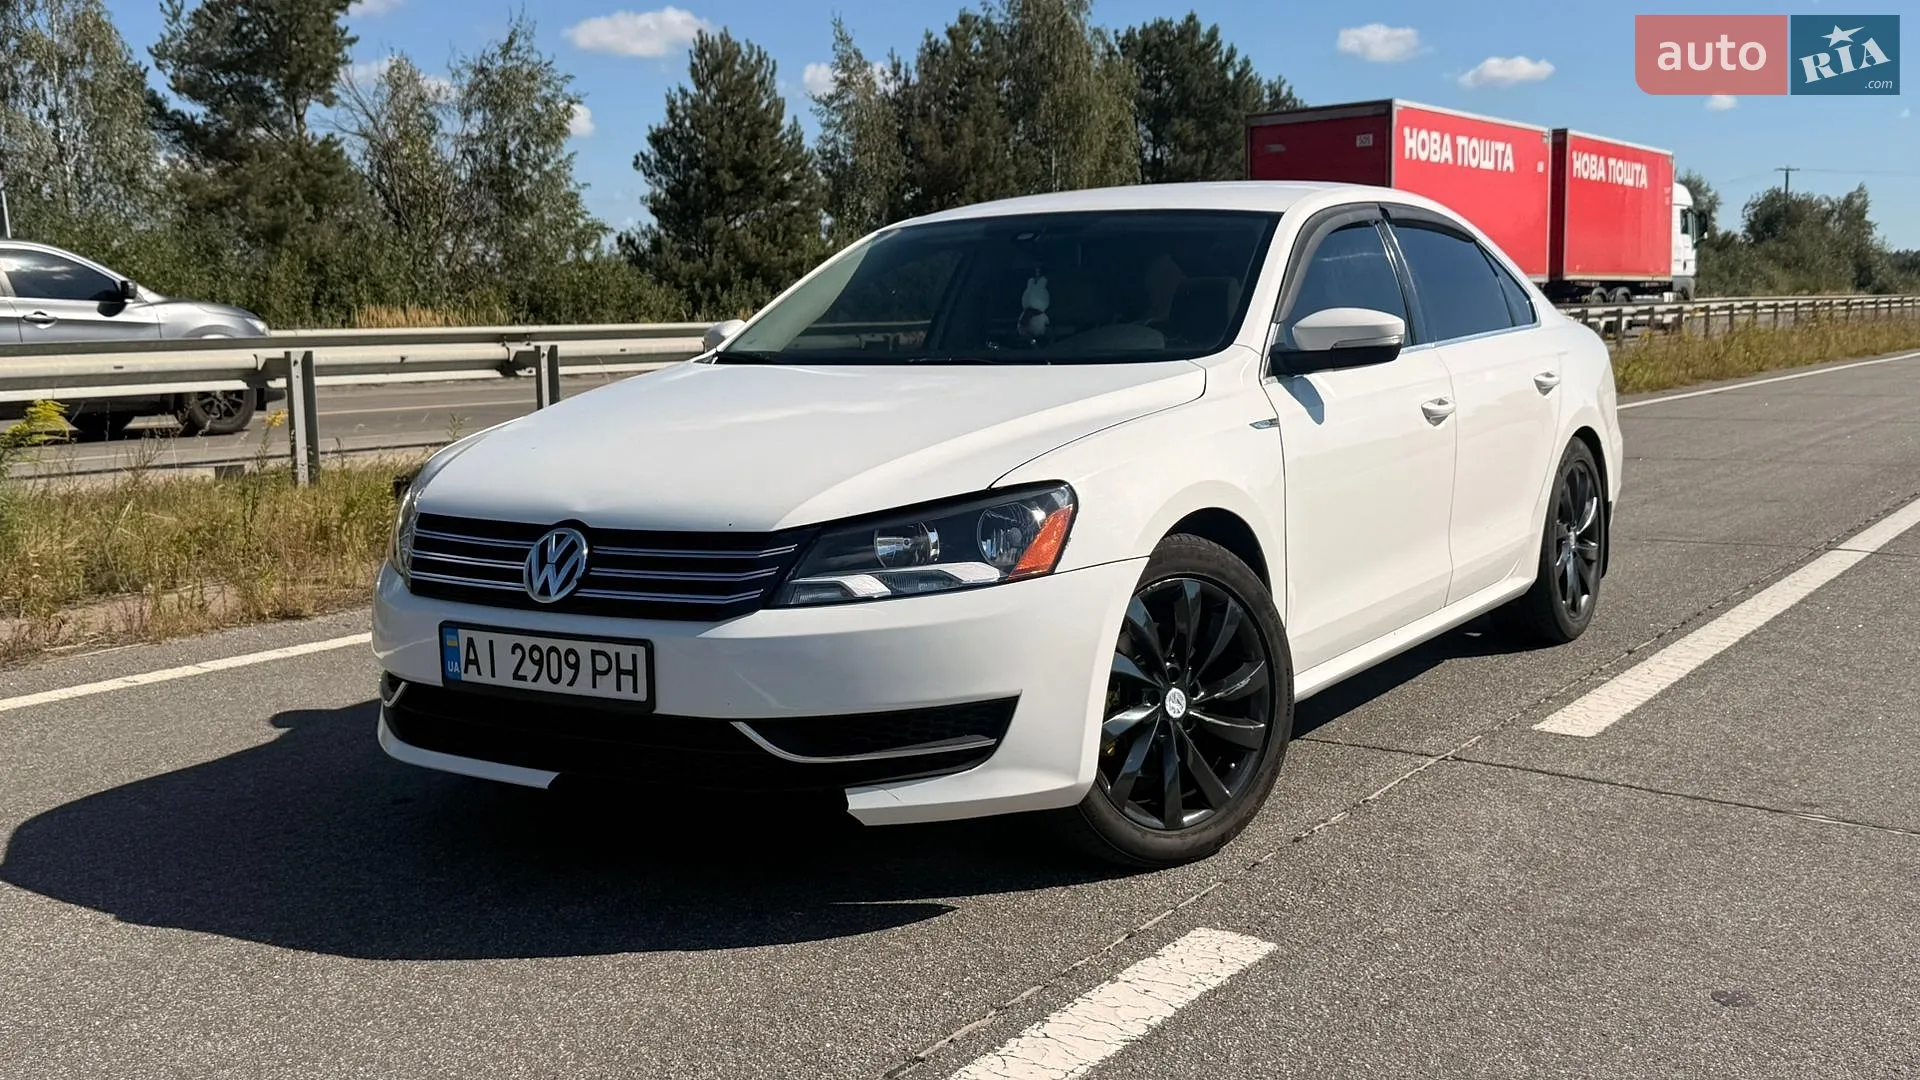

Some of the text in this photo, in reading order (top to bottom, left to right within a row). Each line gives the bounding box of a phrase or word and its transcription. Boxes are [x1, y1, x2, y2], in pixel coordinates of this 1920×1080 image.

[1403, 126, 1514, 172] НОВА ПОШТА
[1572, 151, 1606, 182] НОВА
[1608, 157, 1648, 189] ПОШТА
[447, 660, 460, 672] UA
[463, 637, 639, 694] AI 2909 PH
